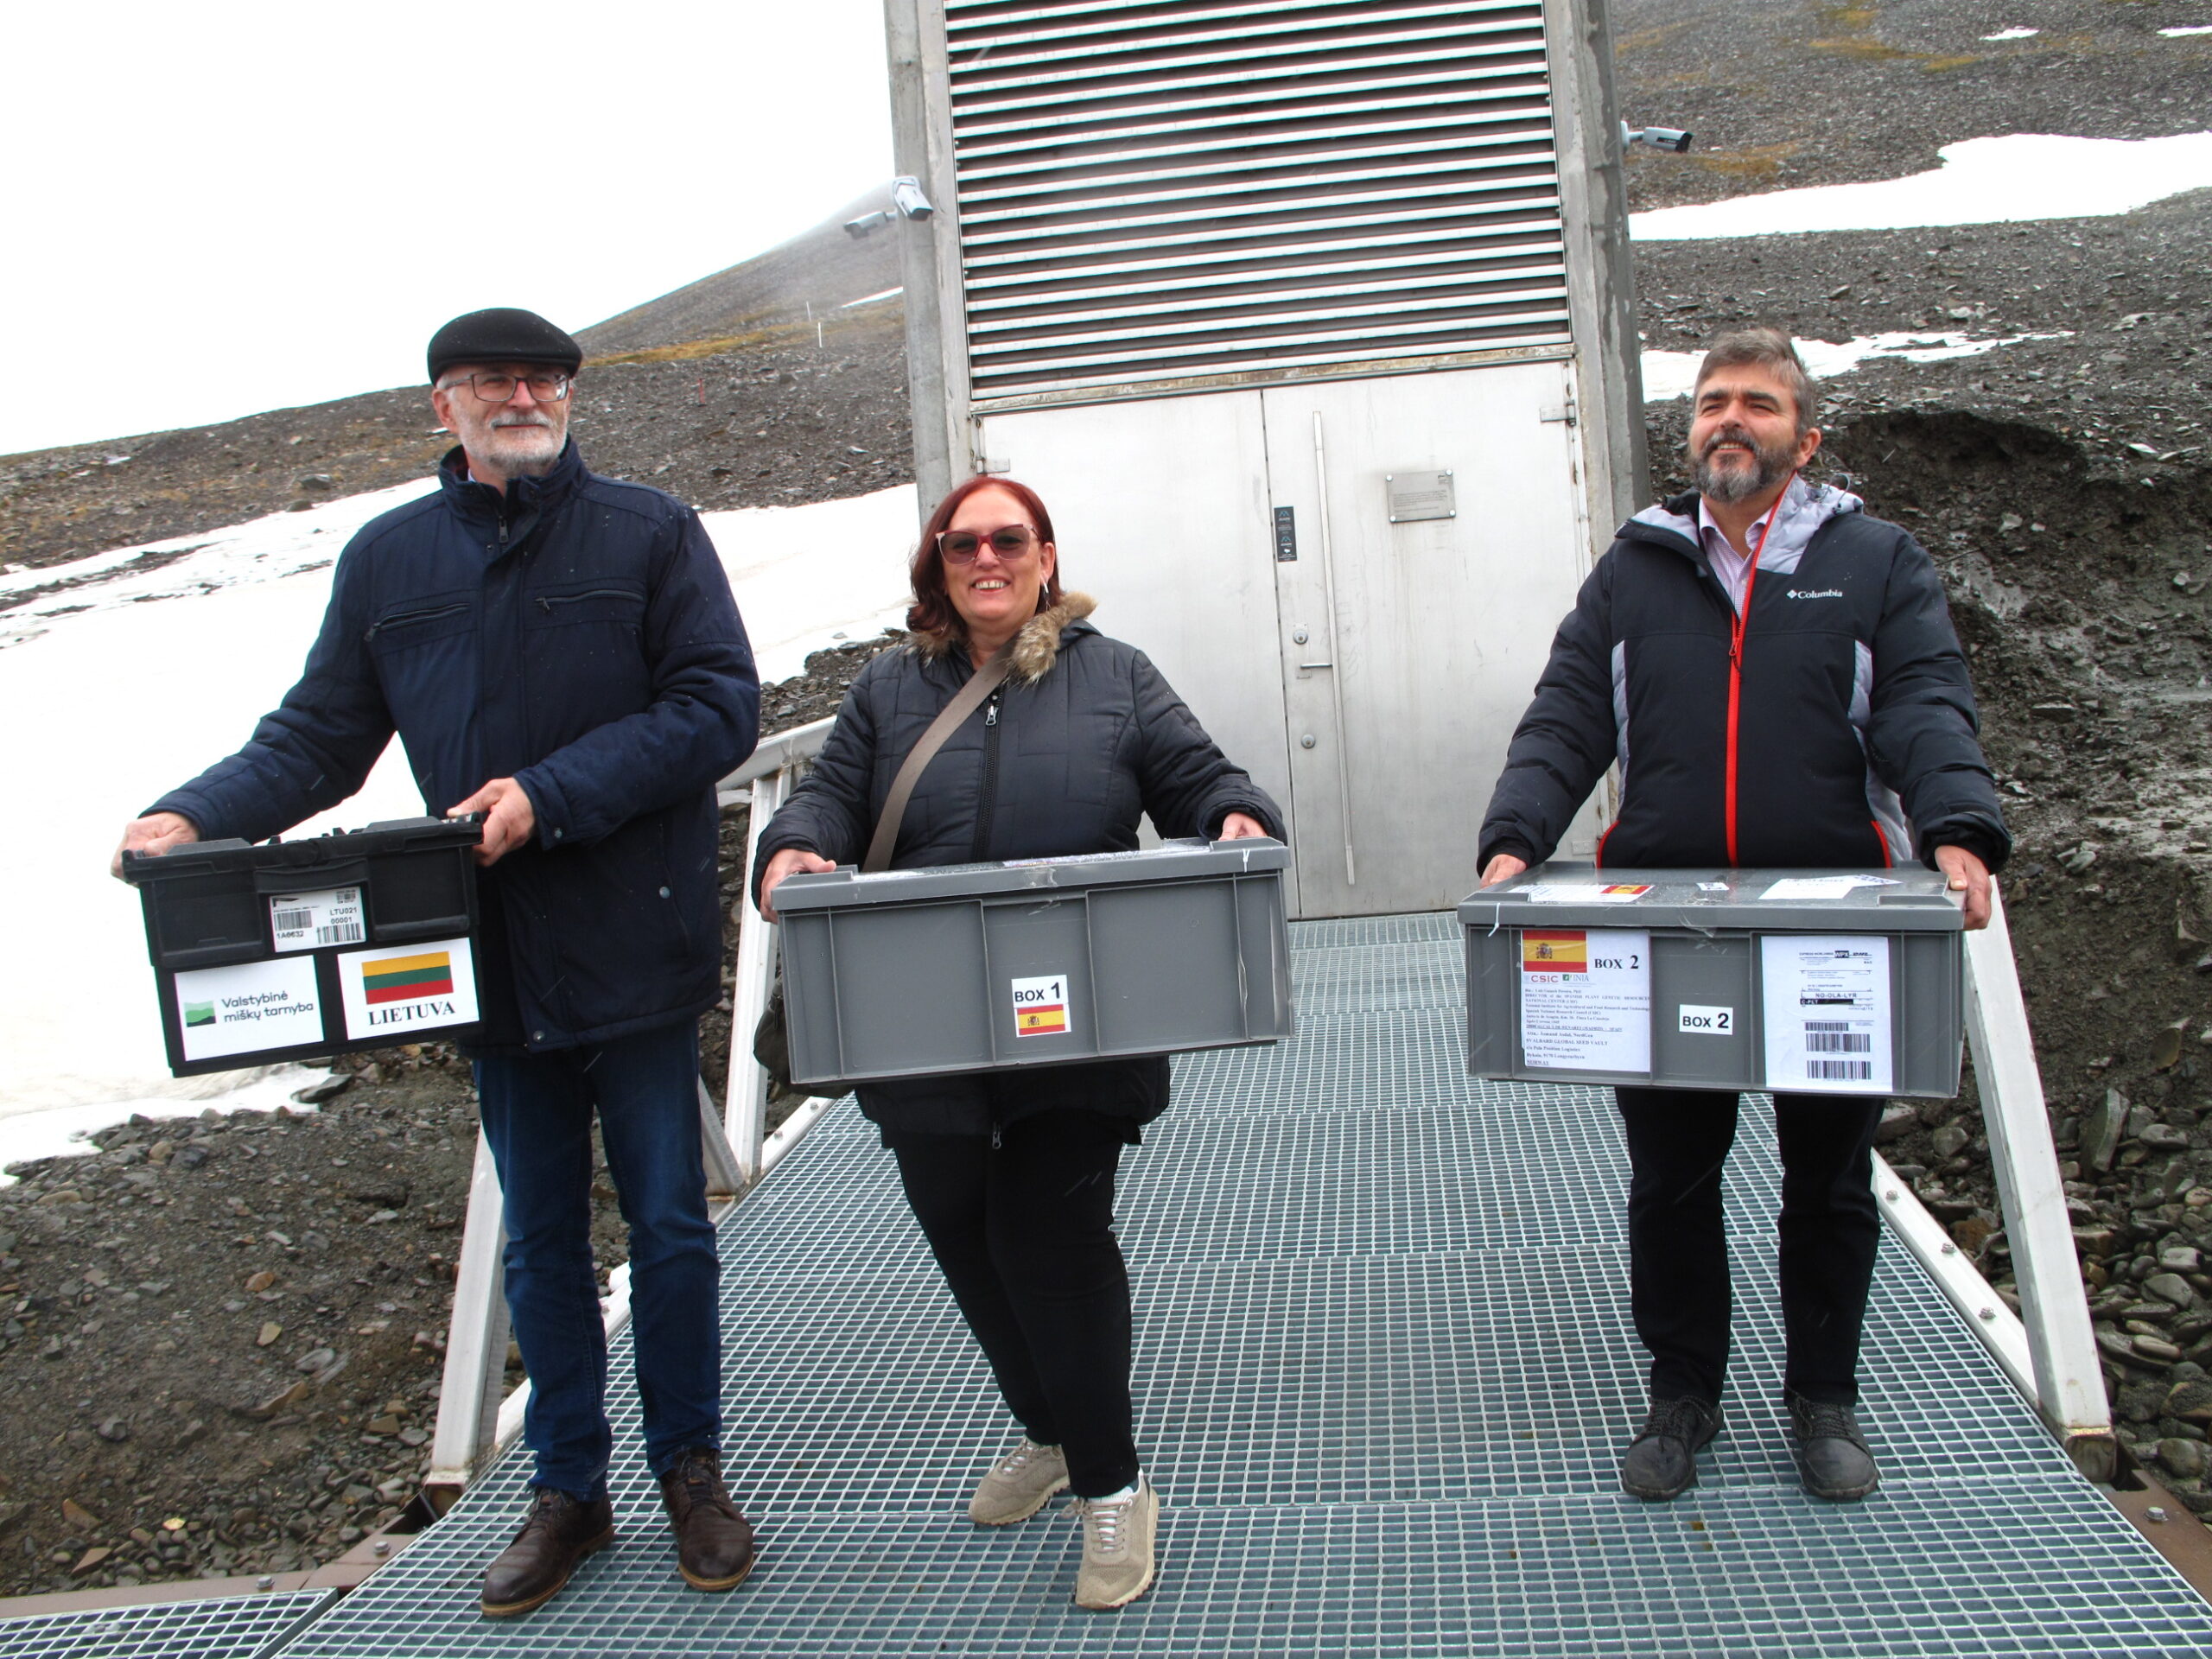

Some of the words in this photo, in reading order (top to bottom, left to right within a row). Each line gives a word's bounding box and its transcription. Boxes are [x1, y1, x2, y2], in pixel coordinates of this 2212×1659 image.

[1797, 588, 1843, 599] Columbia
[330, 906, 358, 916] LTU021
[1594, 958, 1623, 969] BOX
[1630, 955, 1639, 969] 2
[221, 990, 289, 1009] Valstybinė
[1014, 989, 1045, 1002] BOX
[1051, 982, 1060, 999] 1
[224, 1008, 262, 1023] miškų
[264, 1001, 314, 1018] tarnyba
[368, 1001, 455, 1026] LIETUVA
[1682, 1015, 1711, 1027] BOX
[1718, 1013, 1729, 1028] 2
